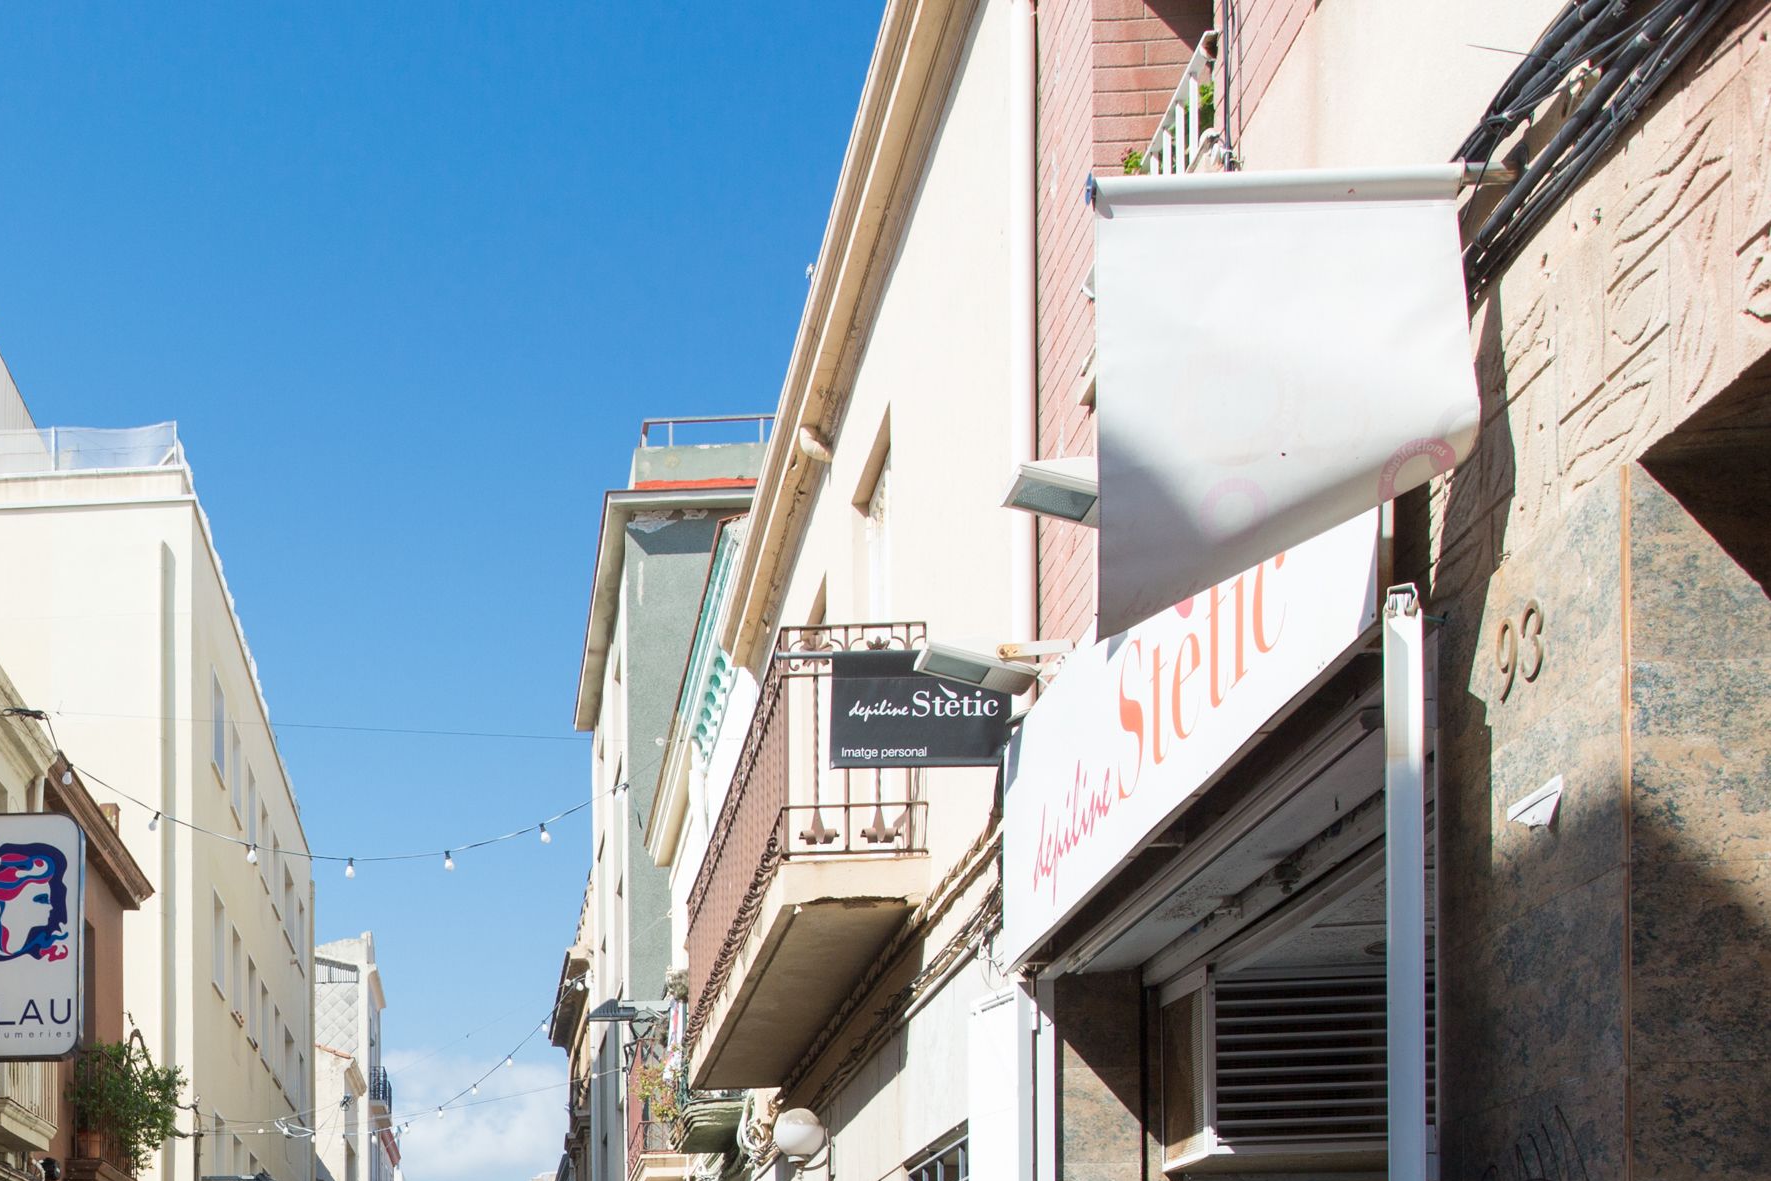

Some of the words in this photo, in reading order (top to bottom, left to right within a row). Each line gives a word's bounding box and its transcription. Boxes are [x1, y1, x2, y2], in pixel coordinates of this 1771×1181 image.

[1495, 597, 1545, 703] 93
[849, 699, 909, 722] depiline
[912, 682, 999, 717] Stètic
[841, 747, 879, 760] Imatge
[881, 746, 928, 759] personal
[1033, 760, 1112, 906] depiline
